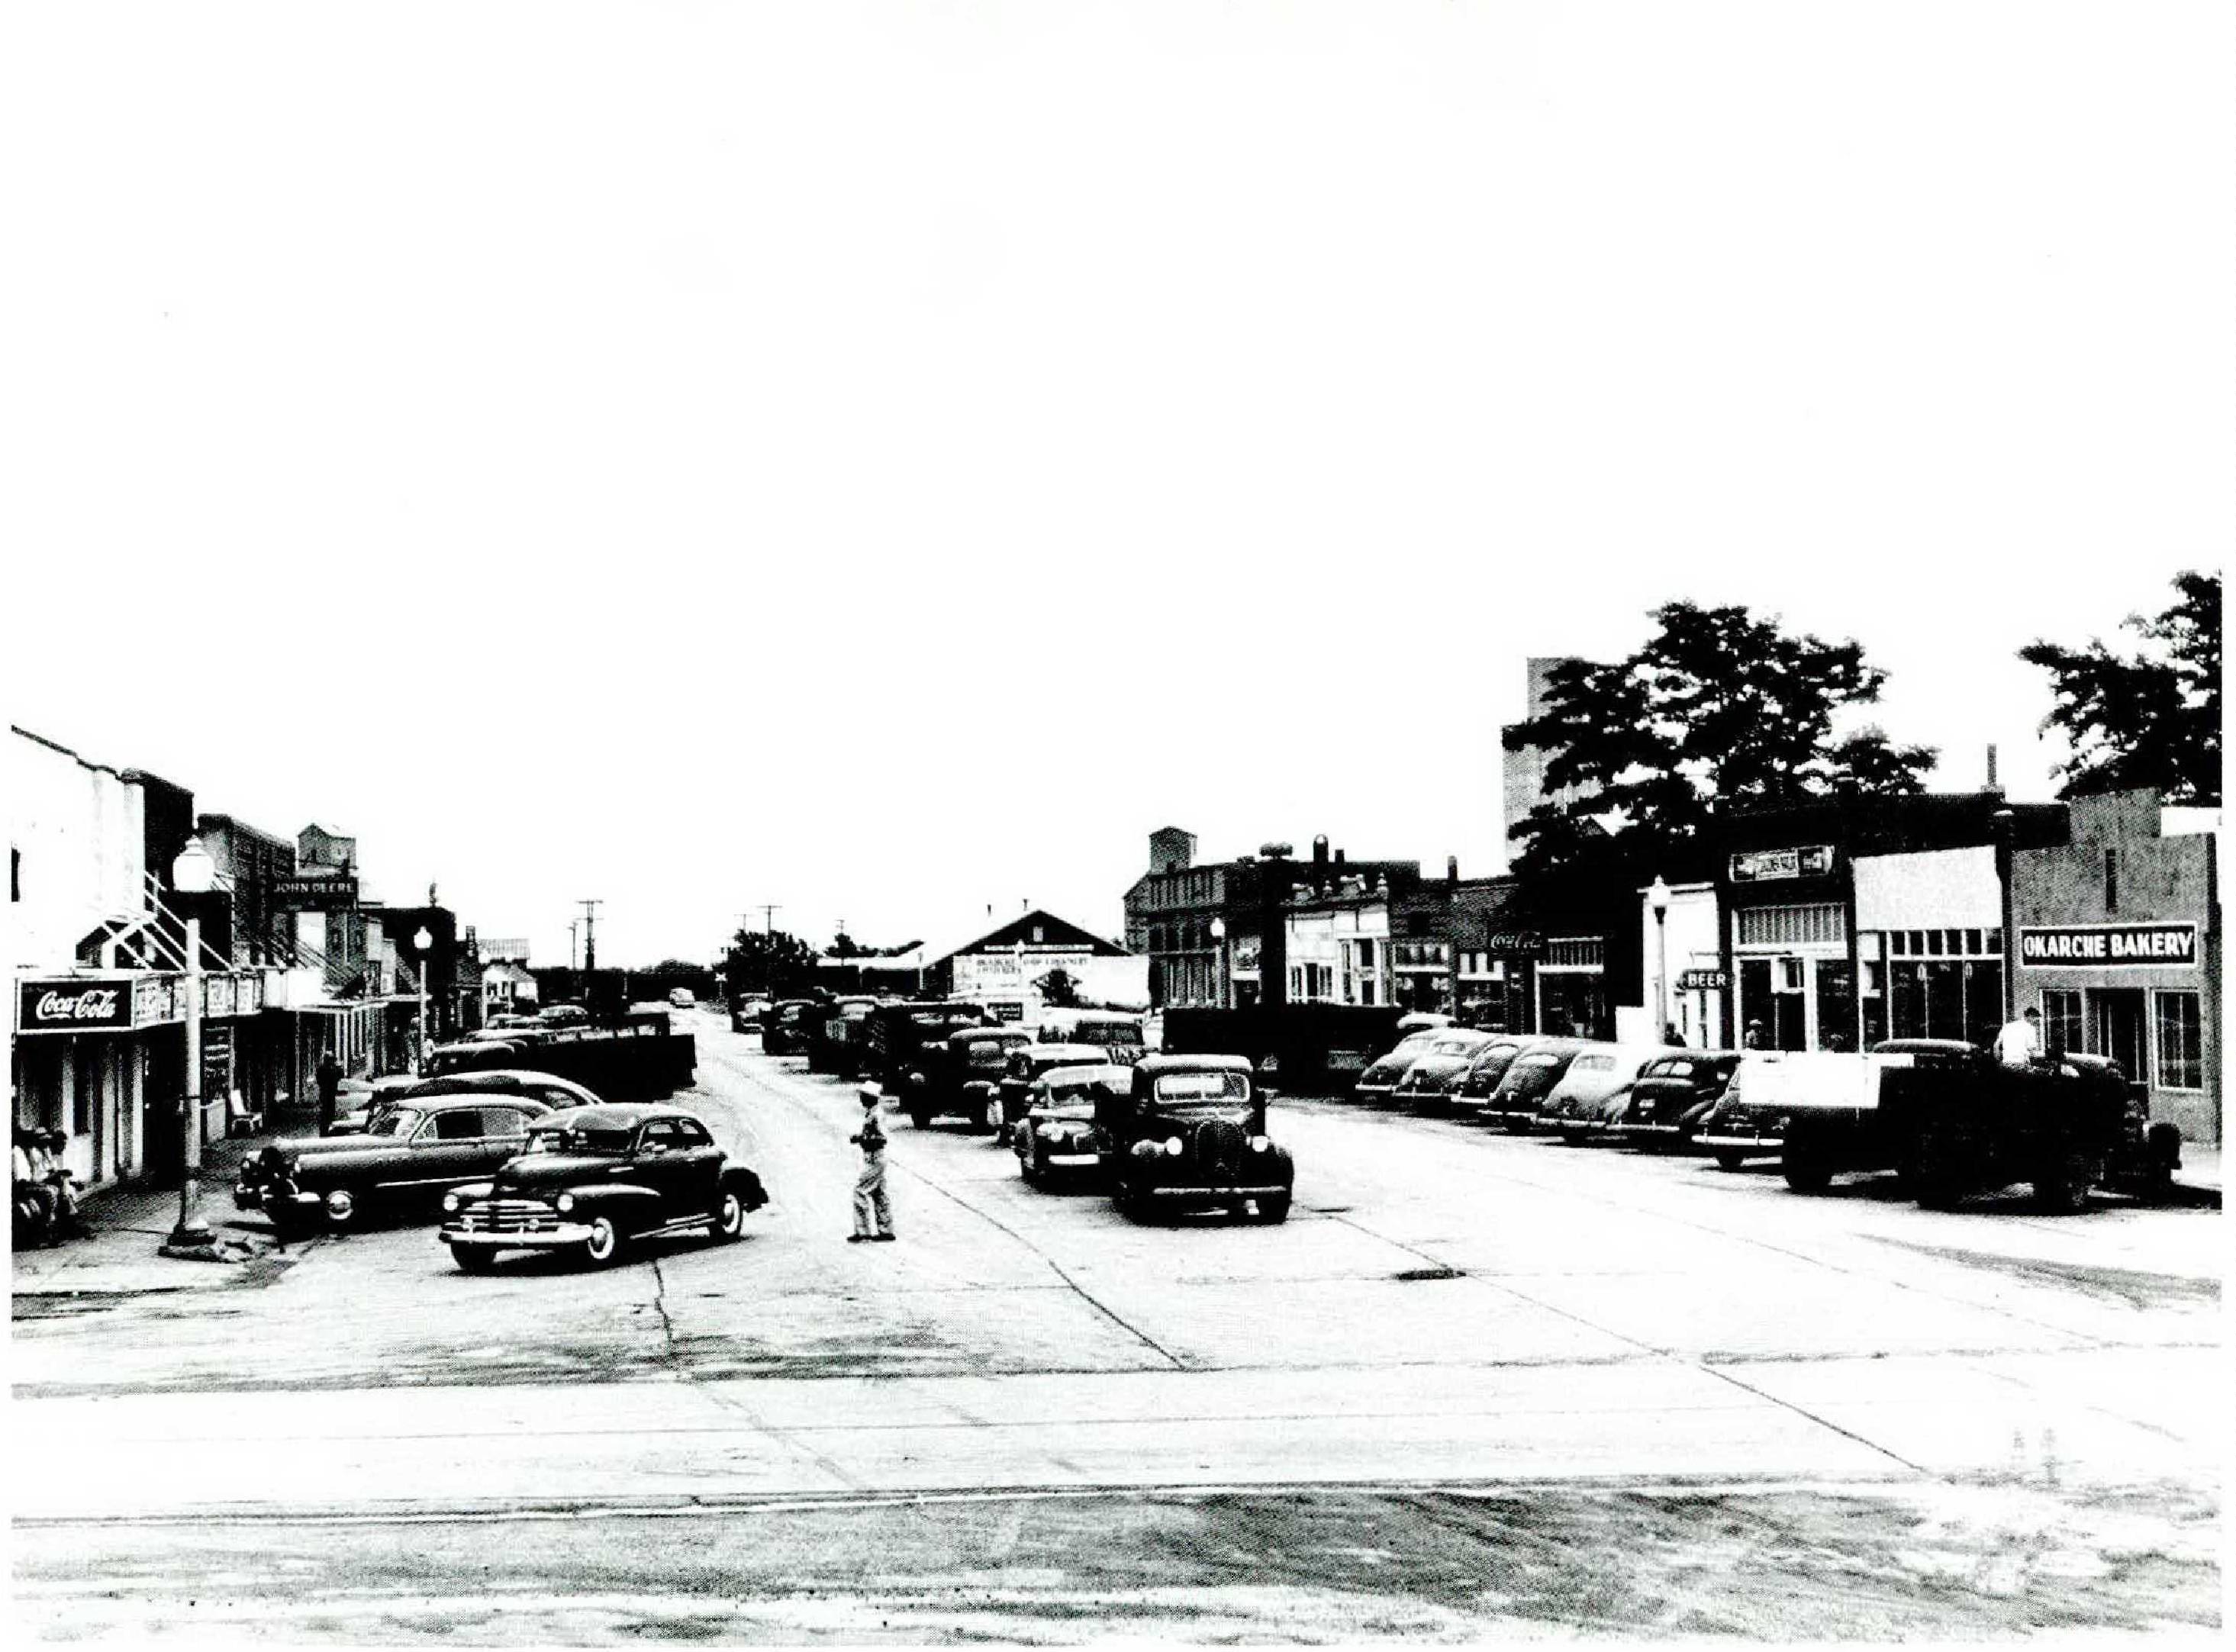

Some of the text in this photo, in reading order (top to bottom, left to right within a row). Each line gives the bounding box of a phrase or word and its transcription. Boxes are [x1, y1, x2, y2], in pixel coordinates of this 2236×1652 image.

[274, 883, 308, 893] JOHN
[2023, 931, 2193, 958] OKARCHE BAKERY
[1688, 973, 1726, 987] BEER
[36, 990, 119, 1020] Coca-Cola
